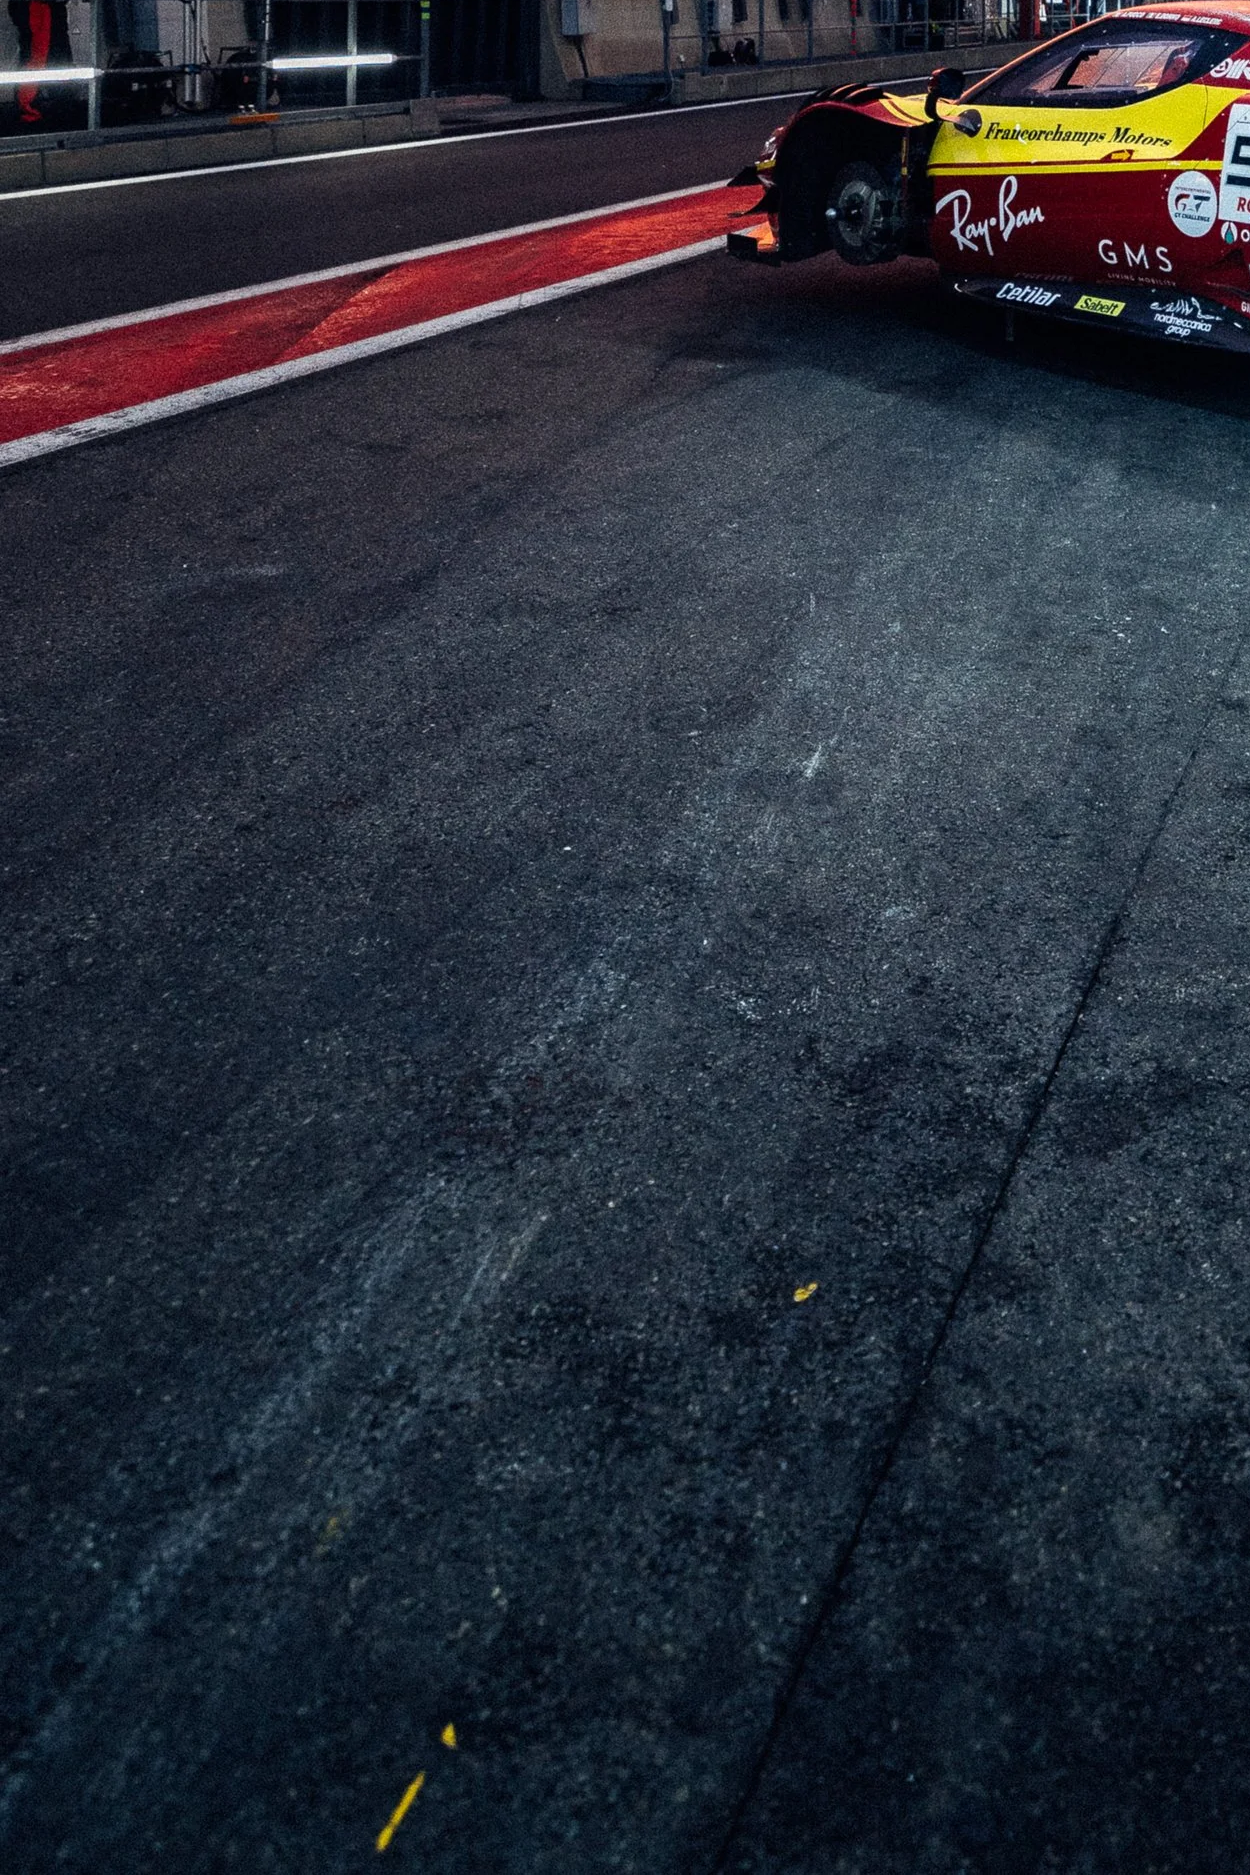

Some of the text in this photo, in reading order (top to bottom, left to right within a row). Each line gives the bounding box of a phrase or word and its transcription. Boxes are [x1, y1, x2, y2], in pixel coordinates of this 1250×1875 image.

[985, 122, 1172, 147] Francorchamps Motors
[1182, 212, 1210, 222] CHALLENGE
[1107, 272, 1176, 287] LIVING MOBILITY
[996, 282, 1061, 307] Cetilar
[1080, 297, 1118, 316] Sabelt
[1164, 324, 1191, 338] group
